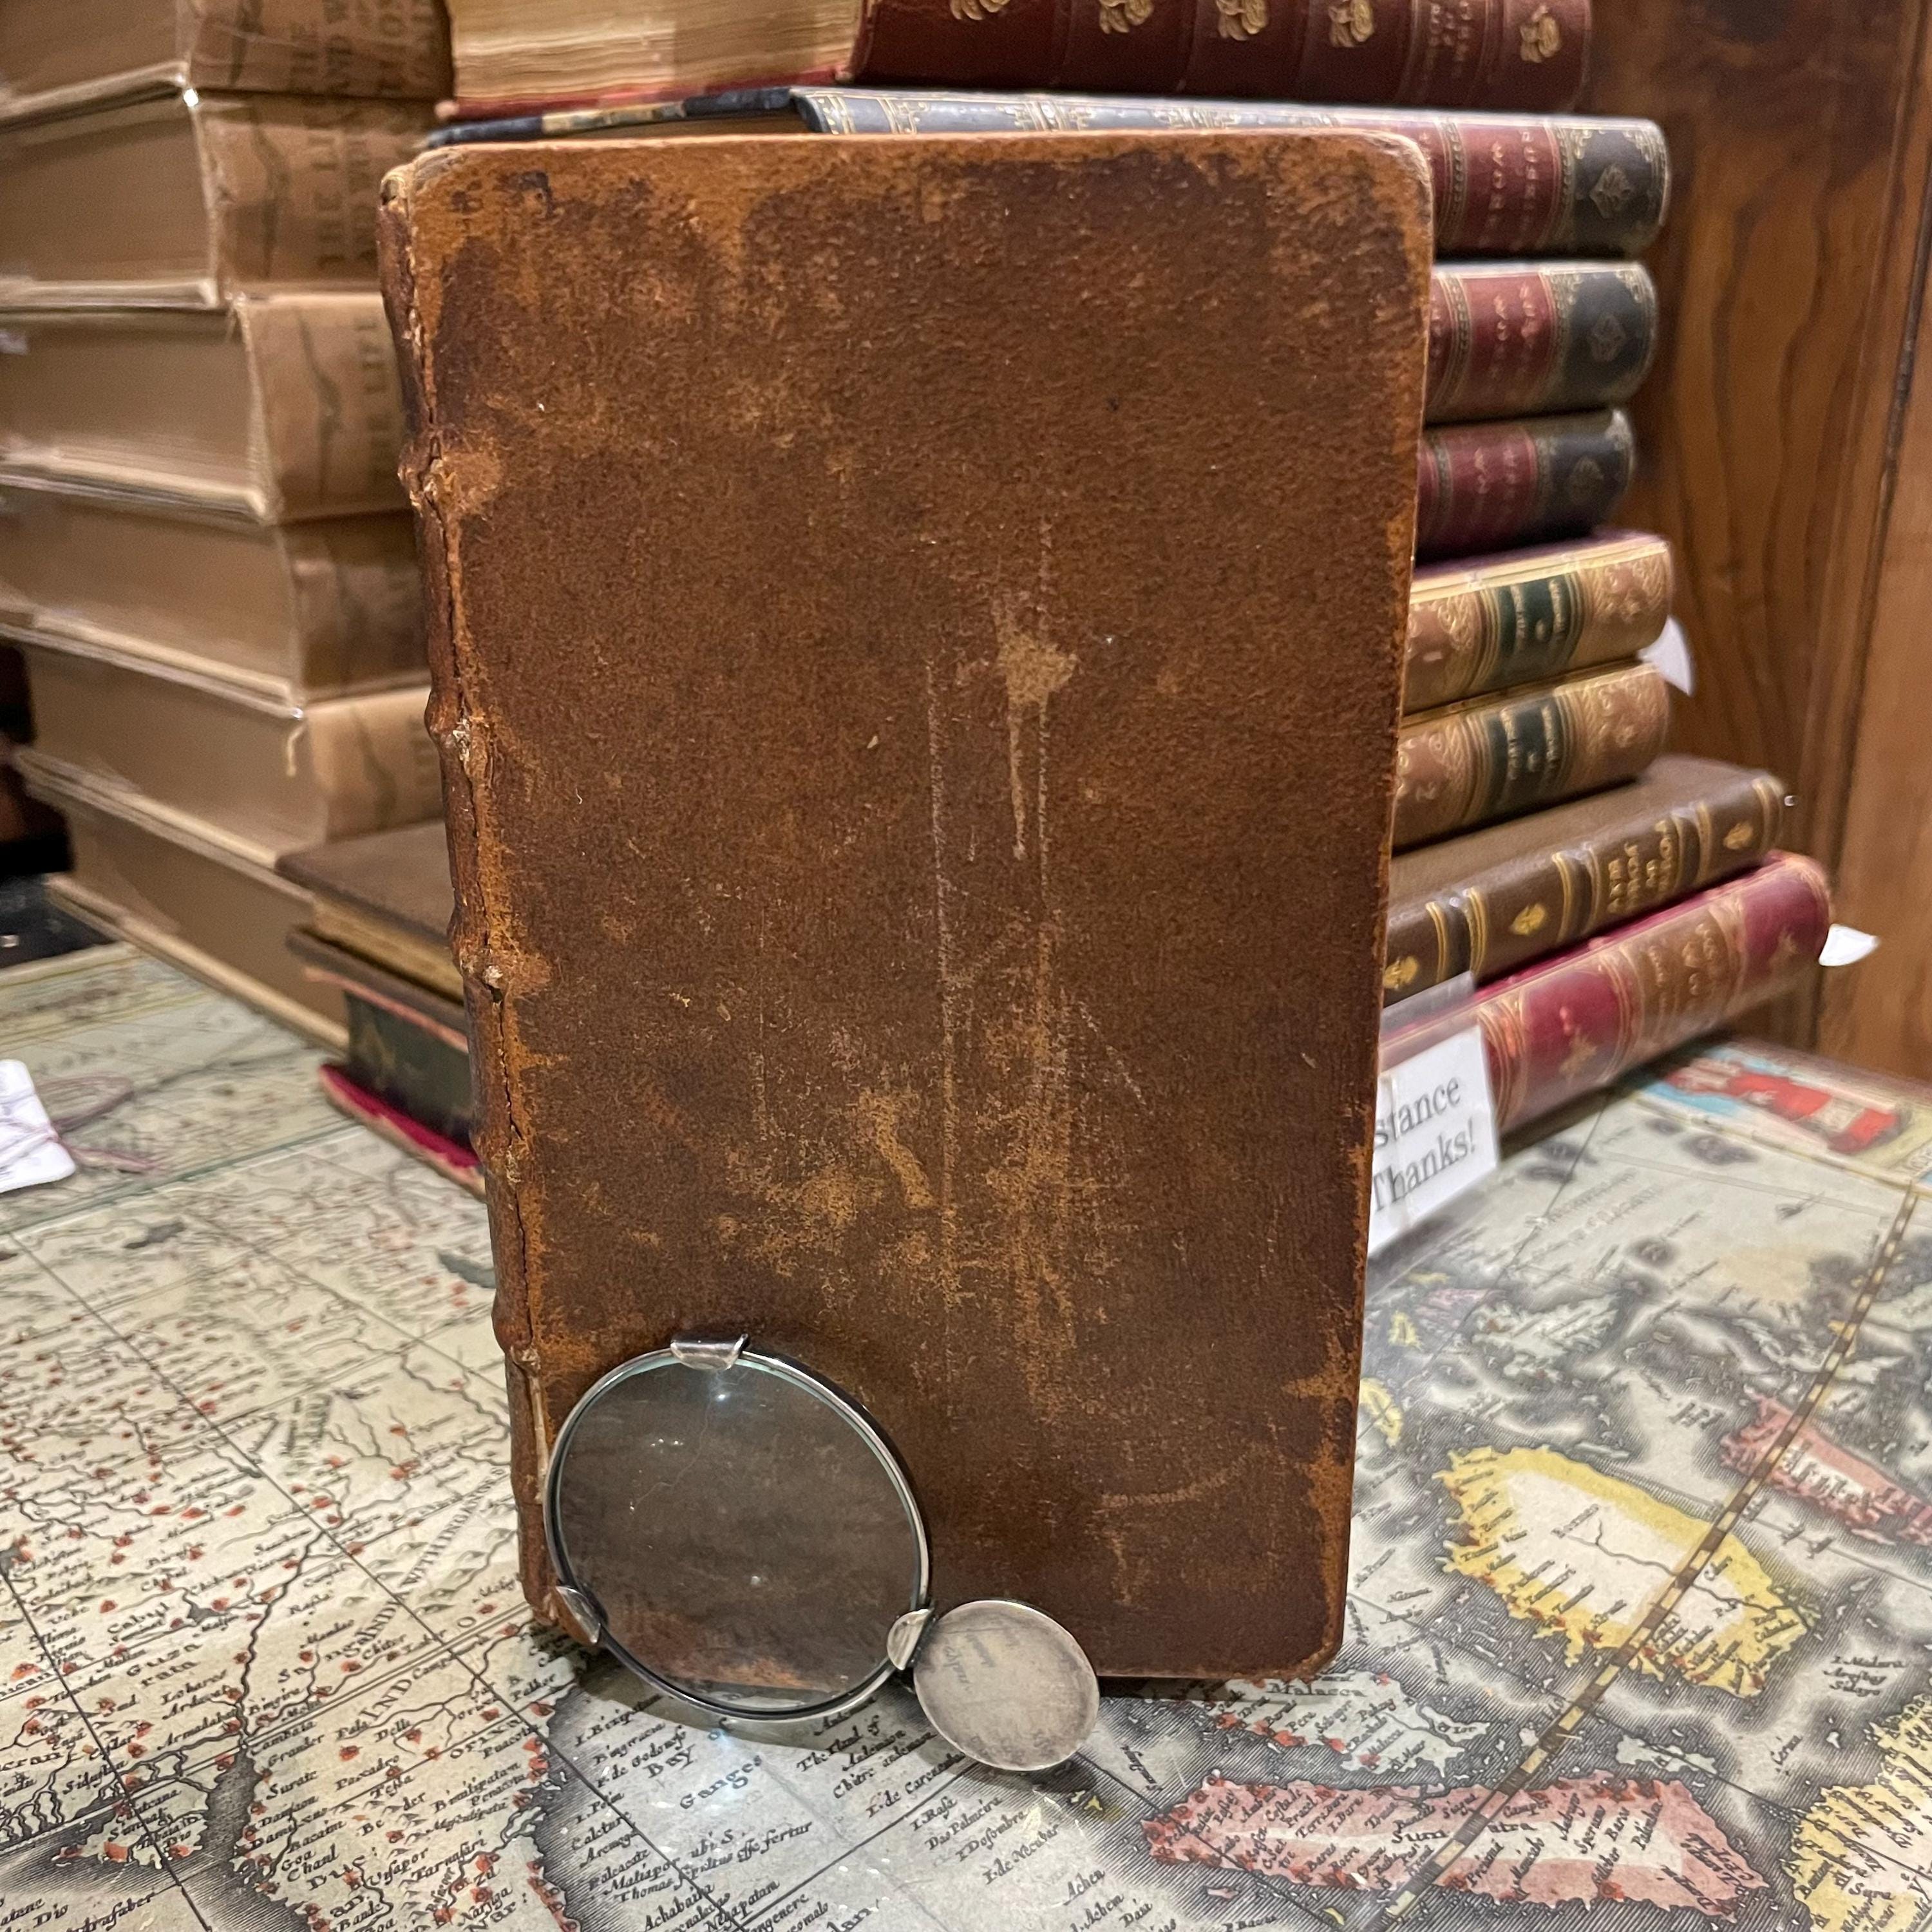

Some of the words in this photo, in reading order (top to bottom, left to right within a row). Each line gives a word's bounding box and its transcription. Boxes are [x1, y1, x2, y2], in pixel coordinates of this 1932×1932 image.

[1372, 1117, 1476, 1212] Thanks!
[679, 1755, 762, 1810] Ganges
[281, 1849, 316, 1872] Goa
[33, 1902, 69, 1929] Dio
